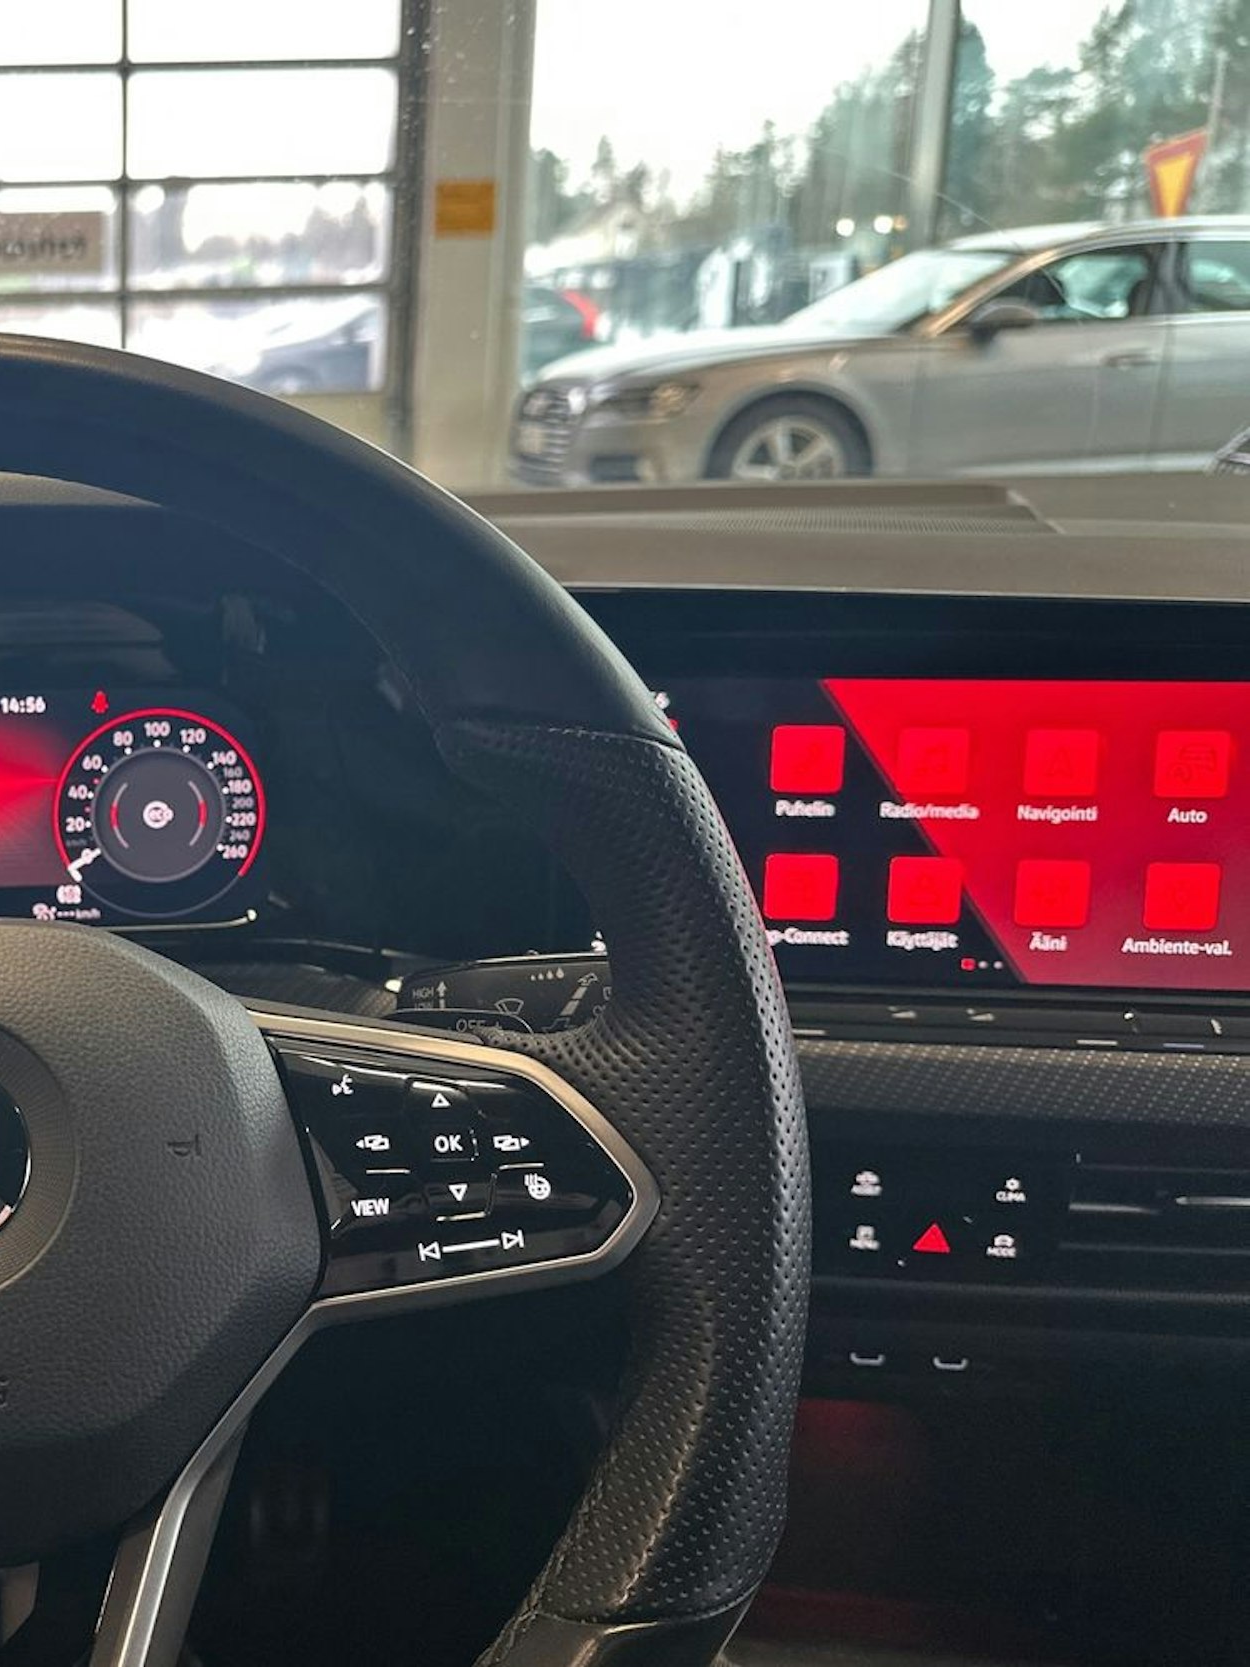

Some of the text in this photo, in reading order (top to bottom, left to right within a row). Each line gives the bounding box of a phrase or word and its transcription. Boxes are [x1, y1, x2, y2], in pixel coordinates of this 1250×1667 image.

[0, 696, 46, 713] 14:56
[144, 721, 170, 737] 100
[180, 728, 206, 744] 120
[113, 731, 133, 747] 80
[82, 754, 102, 771] 60
[212, 751, 237, 766] 140
[68, 785, 87, 800] 40
[227, 779, 252, 794] 180
[879, 801, 979, 820] Radio/media
[1018, 805, 1097, 824] Navigointi
[1168, 808, 1207, 823] Auto
[66, 816, 85, 832] 20
[232, 811, 257, 827] 220
[222, 844, 248, 860] 260
[1122, 938, 1232, 955] Ambiente-val.
[412, 986, 435, 999] HIGH
[435, 1135, 462, 1152] OK
[351, 1198, 389, 1216] VIEW
